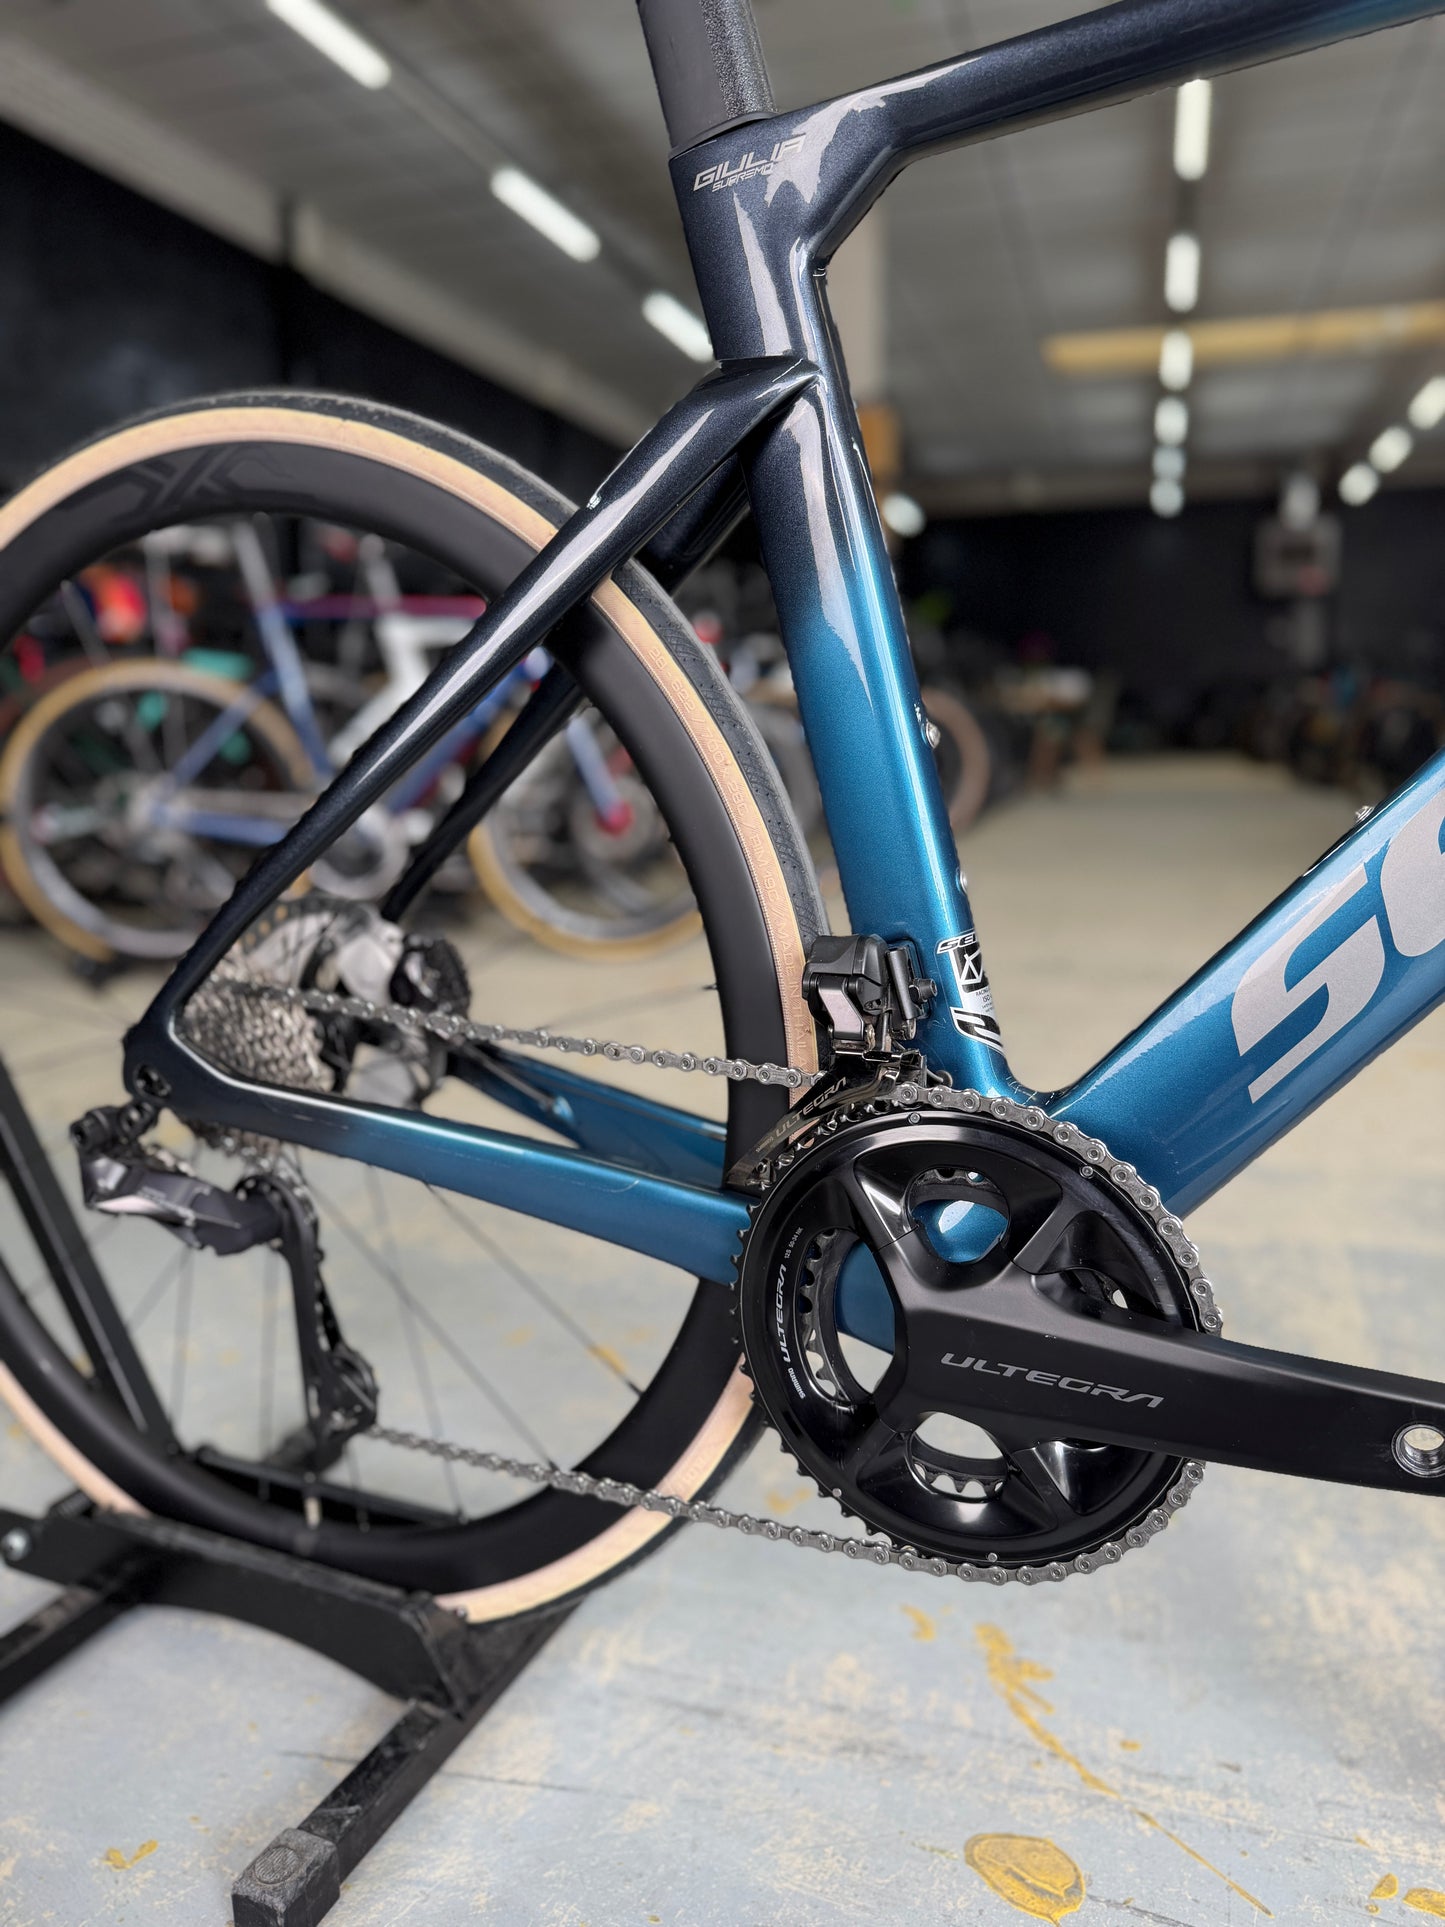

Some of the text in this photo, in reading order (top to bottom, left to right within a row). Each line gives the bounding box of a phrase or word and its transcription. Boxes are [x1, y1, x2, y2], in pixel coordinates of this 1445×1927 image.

[693, 132, 806, 192] GIULIA
[712, 164, 774, 192] SUPREMO
[777, 919, 796, 976] MADE
[793, 1003, 808, 1069] THAILA
[775, 1077, 847, 1137] ULTEGRA
[776, 1263, 791, 1363] ULTEGRA
[940, 1352, 1165, 1409] ULTEGRA
